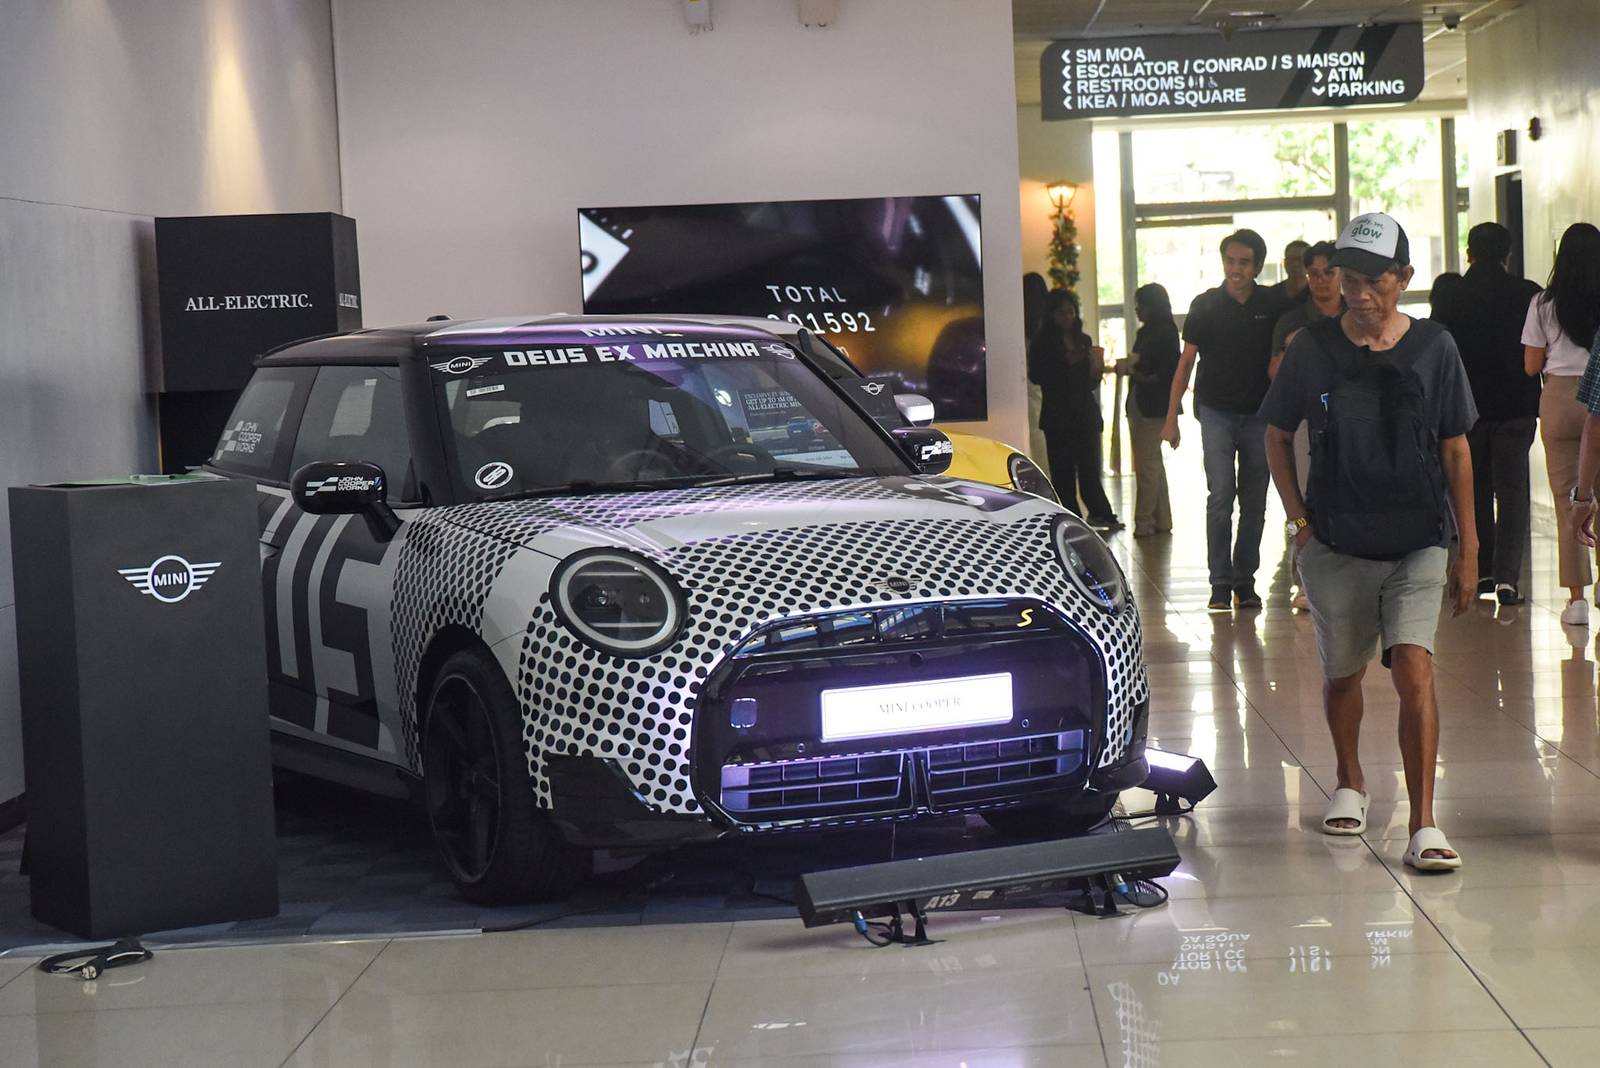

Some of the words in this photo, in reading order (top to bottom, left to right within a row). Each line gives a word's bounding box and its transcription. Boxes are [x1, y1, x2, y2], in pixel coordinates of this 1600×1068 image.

[1075, 48, 1101, 63] SM
[1105, 47, 1145, 62] MOA
[1076, 61, 1179, 78] ESCALATOR
[1183, 60, 1189, 75] /
[1193, 56, 1267, 74] CONRAD
[1271, 55, 1277, 70] /
[1281, 54, 1293, 70] S
[1297, 51, 1365, 69] MAISON
[1327, 66, 1363, 82] ATM
[1077, 75, 1185, 94] RESTROOMS
[1328, 80, 1405, 97] PARKING
[1077, 94, 1118, 109] IKEA
[1121, 94, 1127, 108] /
[1131, 92, 1171, 107] MOA
[1174, 88, 1246, 108] SQUARE
[1351, 224, 1383, 239] glow
[766, 285, 847, 302] TOTAL
[185, 294, 313, 311] ALL-ELECTRIC.
[503, 348, 588, 366] DEUS
[594, 344, 635, 362] EX
[642, 342, 760, 359] MACHINA
[450, 361, 472, 369] MINI
[153, 572, 188, 587] MINI
[1017, 608, 1033, 627] S
[879, 703, 909, 714] MINI
[912, 697, 961, 712] COOPER
